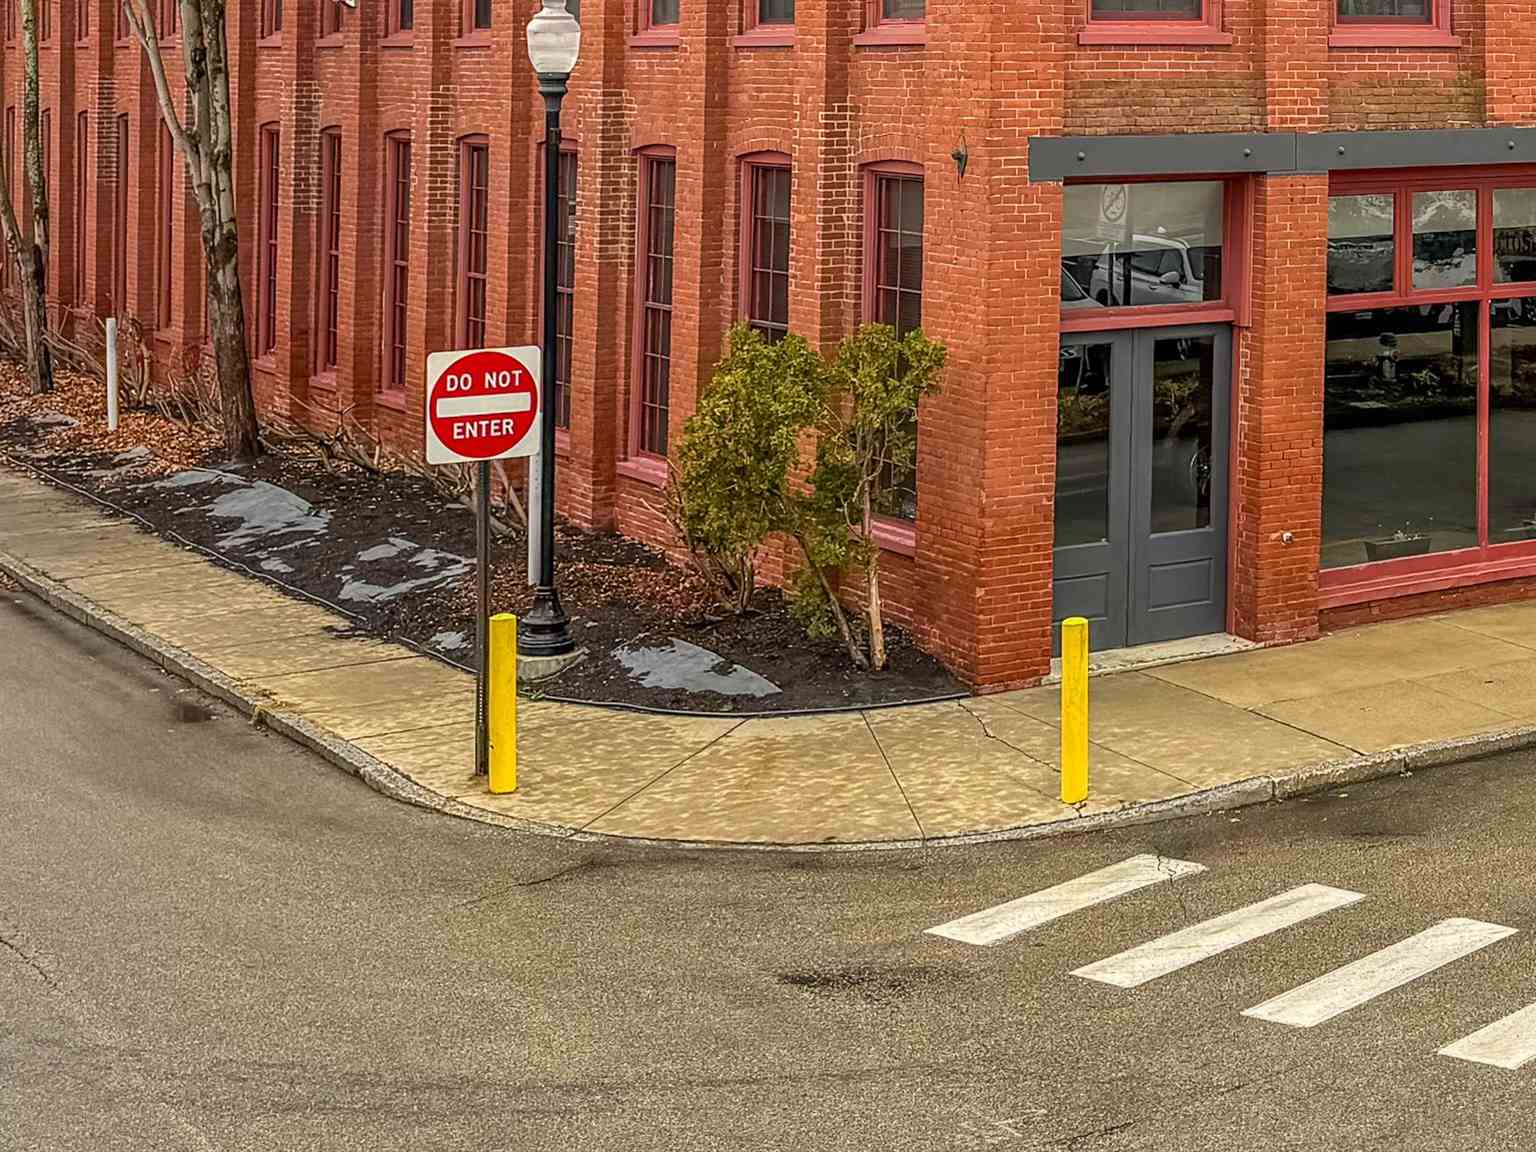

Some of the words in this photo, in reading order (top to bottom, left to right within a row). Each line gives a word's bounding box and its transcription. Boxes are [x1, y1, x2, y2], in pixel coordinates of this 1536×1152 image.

[446, 374, 472, 392] DO
[485, 370, 522, 389] NOT
[453, 418, 514, 440] ENTER
